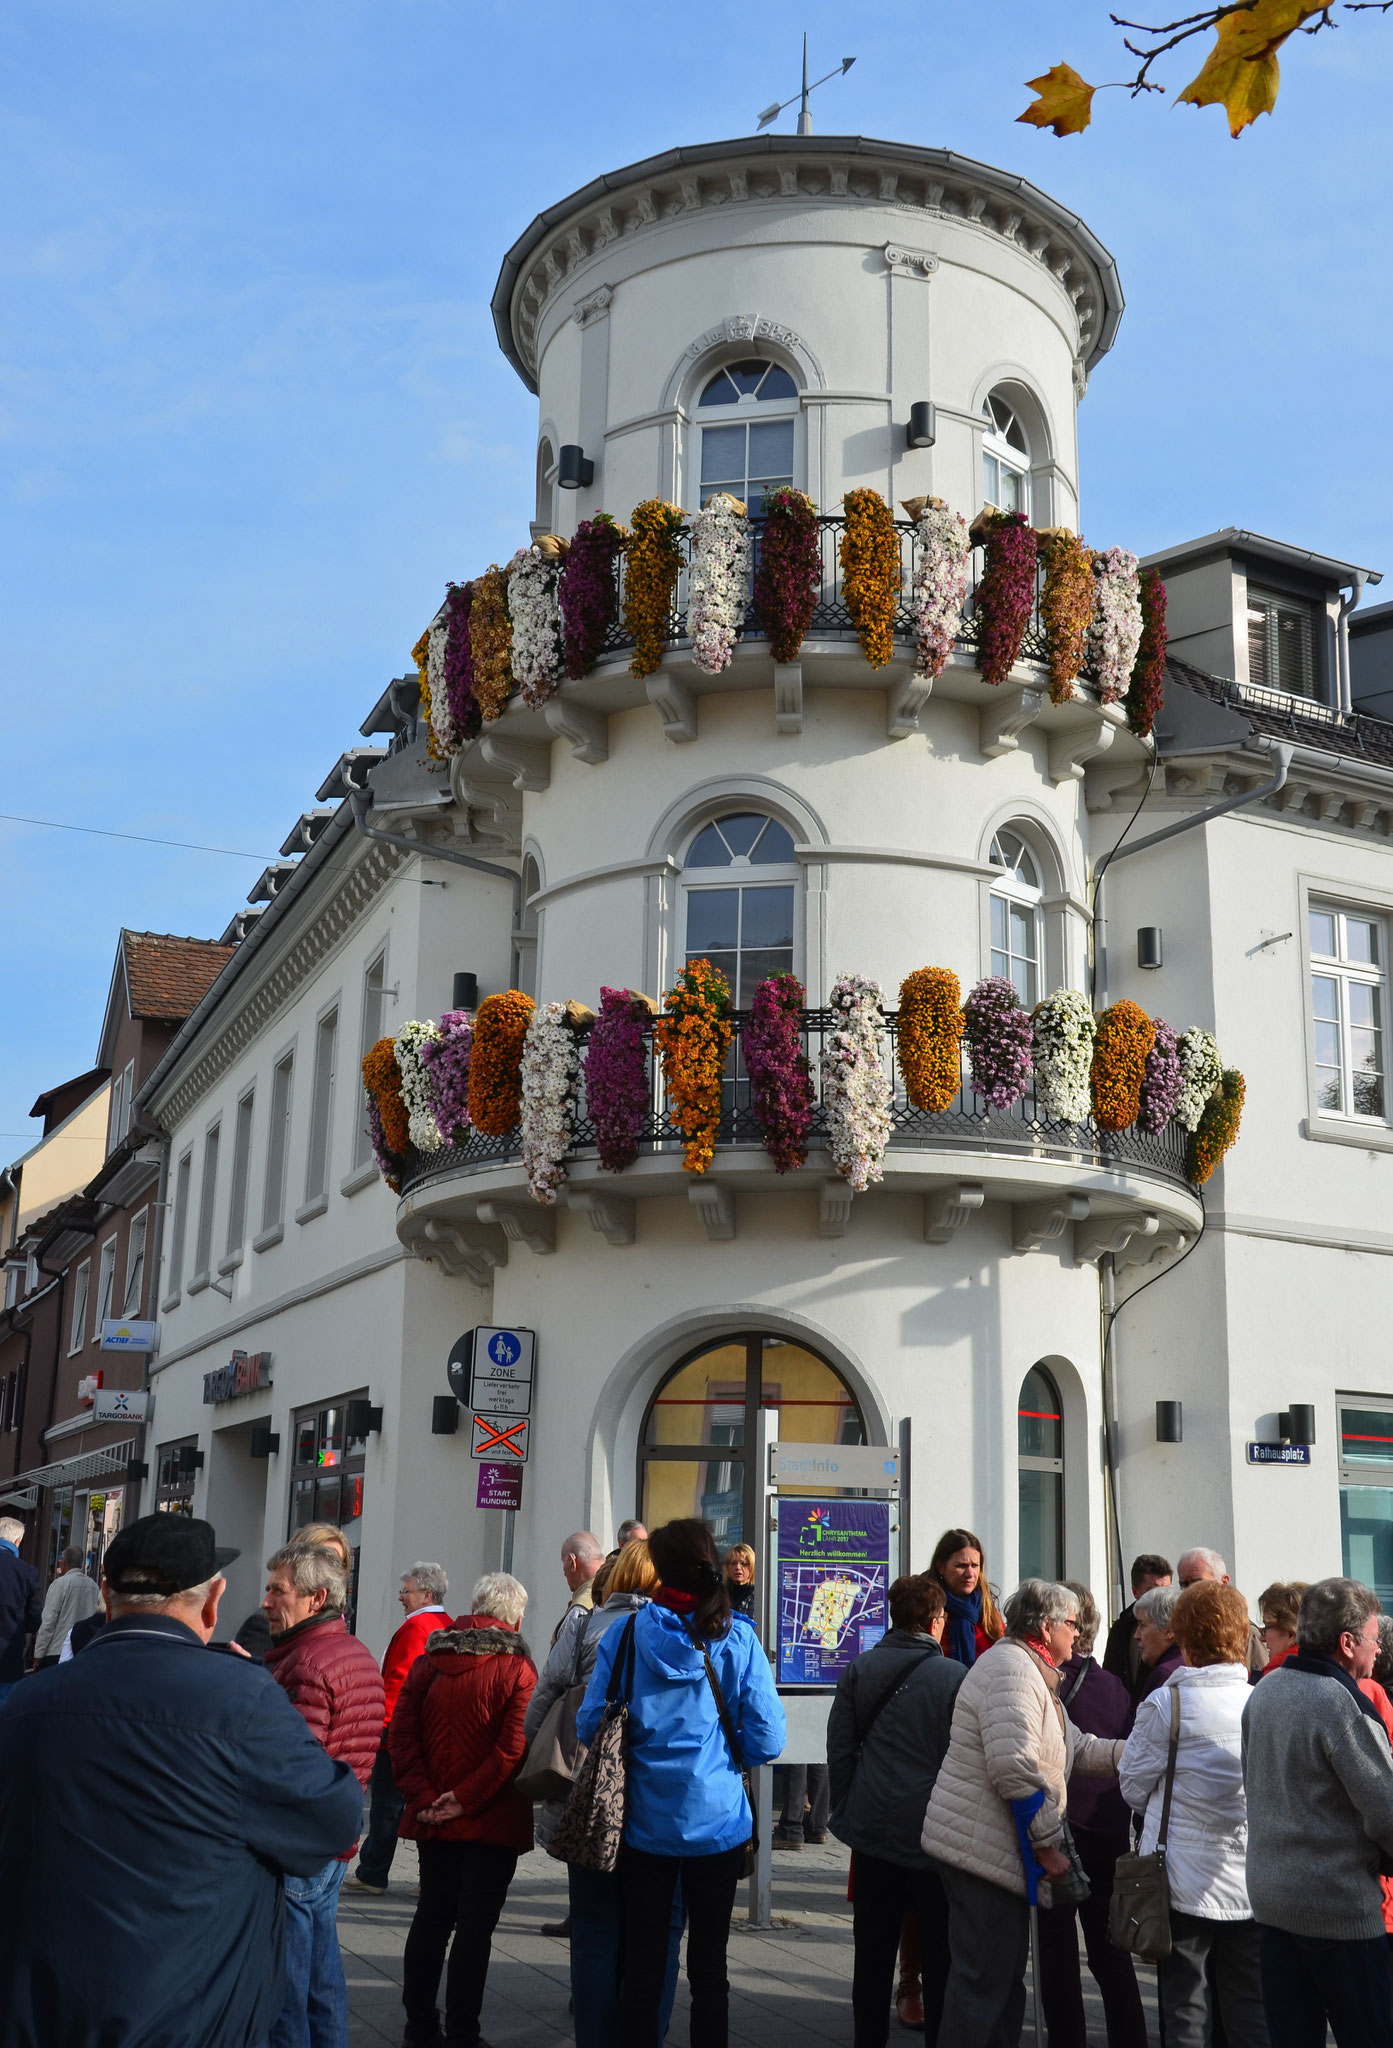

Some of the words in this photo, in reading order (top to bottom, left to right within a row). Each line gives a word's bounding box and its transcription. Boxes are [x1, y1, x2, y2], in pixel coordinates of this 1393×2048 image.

[105, 1336, 130, 1344] ACTIEF
[490, 1367, 516, 1378] ZONE
[483, 1380, 521, 1390] Lieferverkehr
[488, 1397, 515, 1405] werktags
[98, 1411, 143, 1420] TARGOBANK
[1253, 1445, 1305, 1462] Rathausplatz
[778, 1455, 839, 1473] StadtInfo
[488, 1489, 511, 1497] START
[480, 1497, 518, 1507] RUNDWEG
[822, 1529, 868, 1537] CHRYSANTHEMA
[799, 1549, 825, 1557] Herzlich
[827, 1550, 868, 1558] willkommen!
